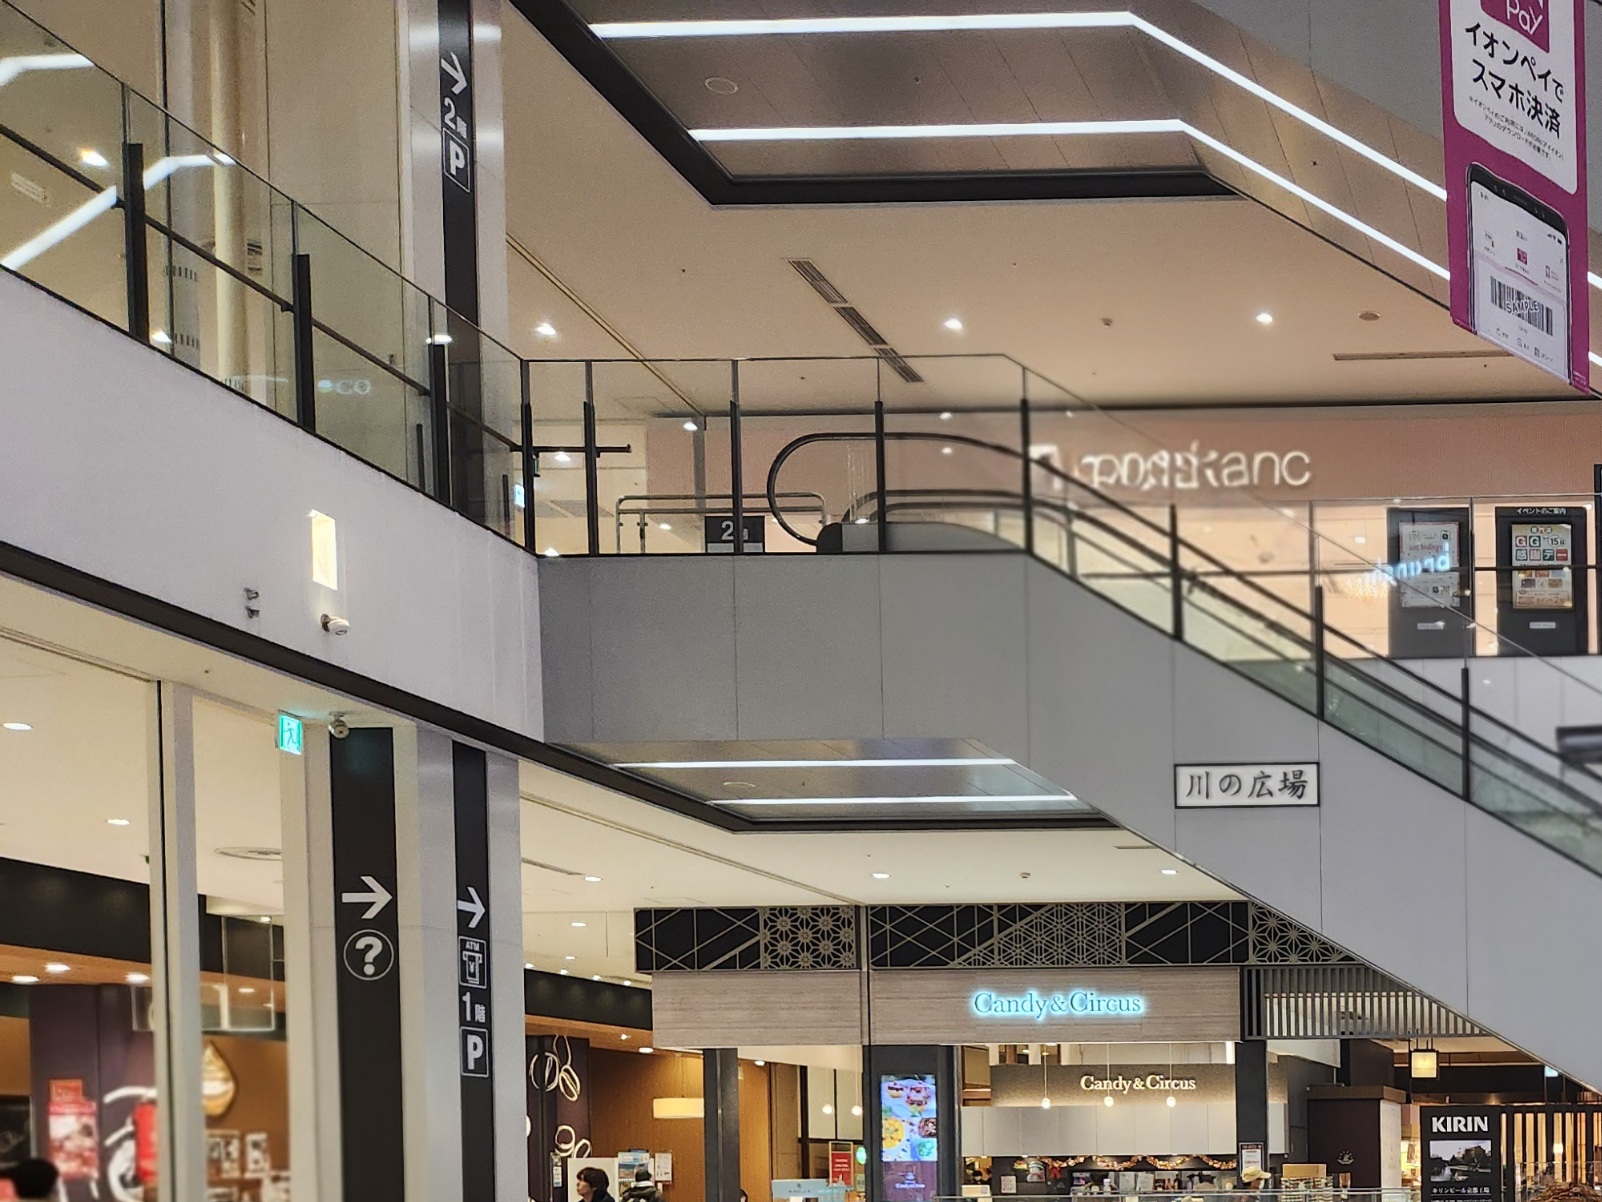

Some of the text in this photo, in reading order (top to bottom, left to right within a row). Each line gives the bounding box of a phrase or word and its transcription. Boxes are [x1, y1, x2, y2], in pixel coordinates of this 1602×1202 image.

[1465, 22, 1564, 103] イオンペイで
[1472, 58, 1561, 139] スマホ決済
[1506, 300, 1539, 315] SAMPLE
[1516, 507, 1567, 515] イベントのご案内
[1186, 769, 1309, 800] 川の広場
[974, 992, 1048, 1019] Candy
[1070, 992, 1141, 1013] Circus
[1080, 1075, 1132, 1095] Candy
[1146, 1075, 1196, 1091] Circus
[1432, 1117, 1489, 1133] KIRIN
